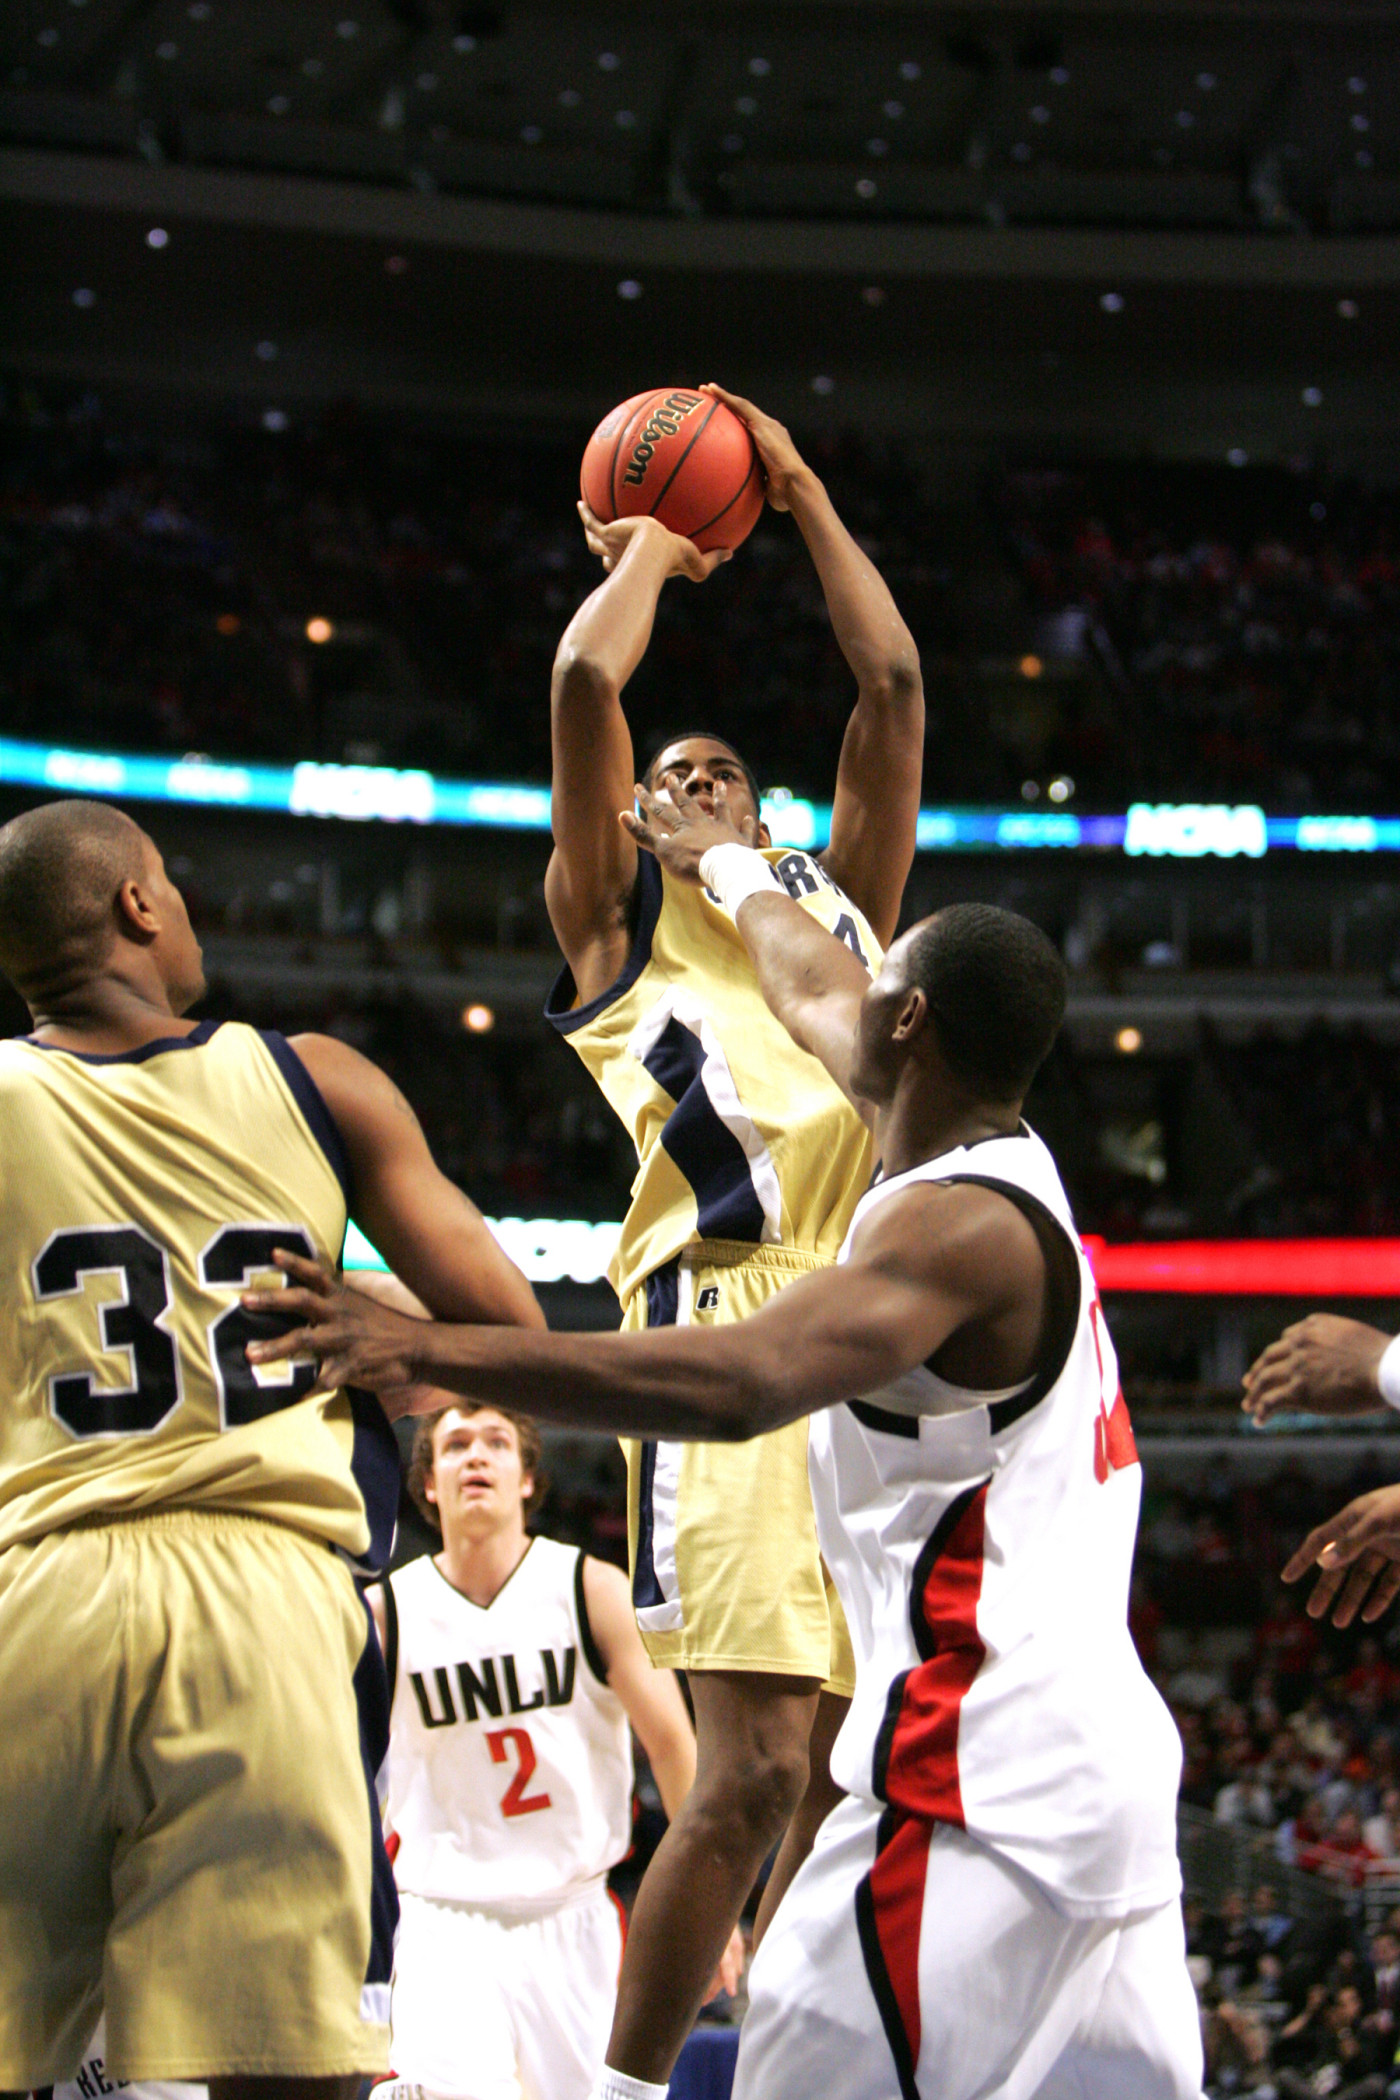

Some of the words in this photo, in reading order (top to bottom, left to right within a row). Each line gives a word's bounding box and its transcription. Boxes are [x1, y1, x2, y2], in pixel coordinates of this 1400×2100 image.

[623, 391, 705, 488] Wilson
[31, 1221, 318, 1441] 32
[696, 1286, 719, 1311] R
[408, 1646, 576, 1730] UNLV
[484, 1727, 552, 1818] 2
